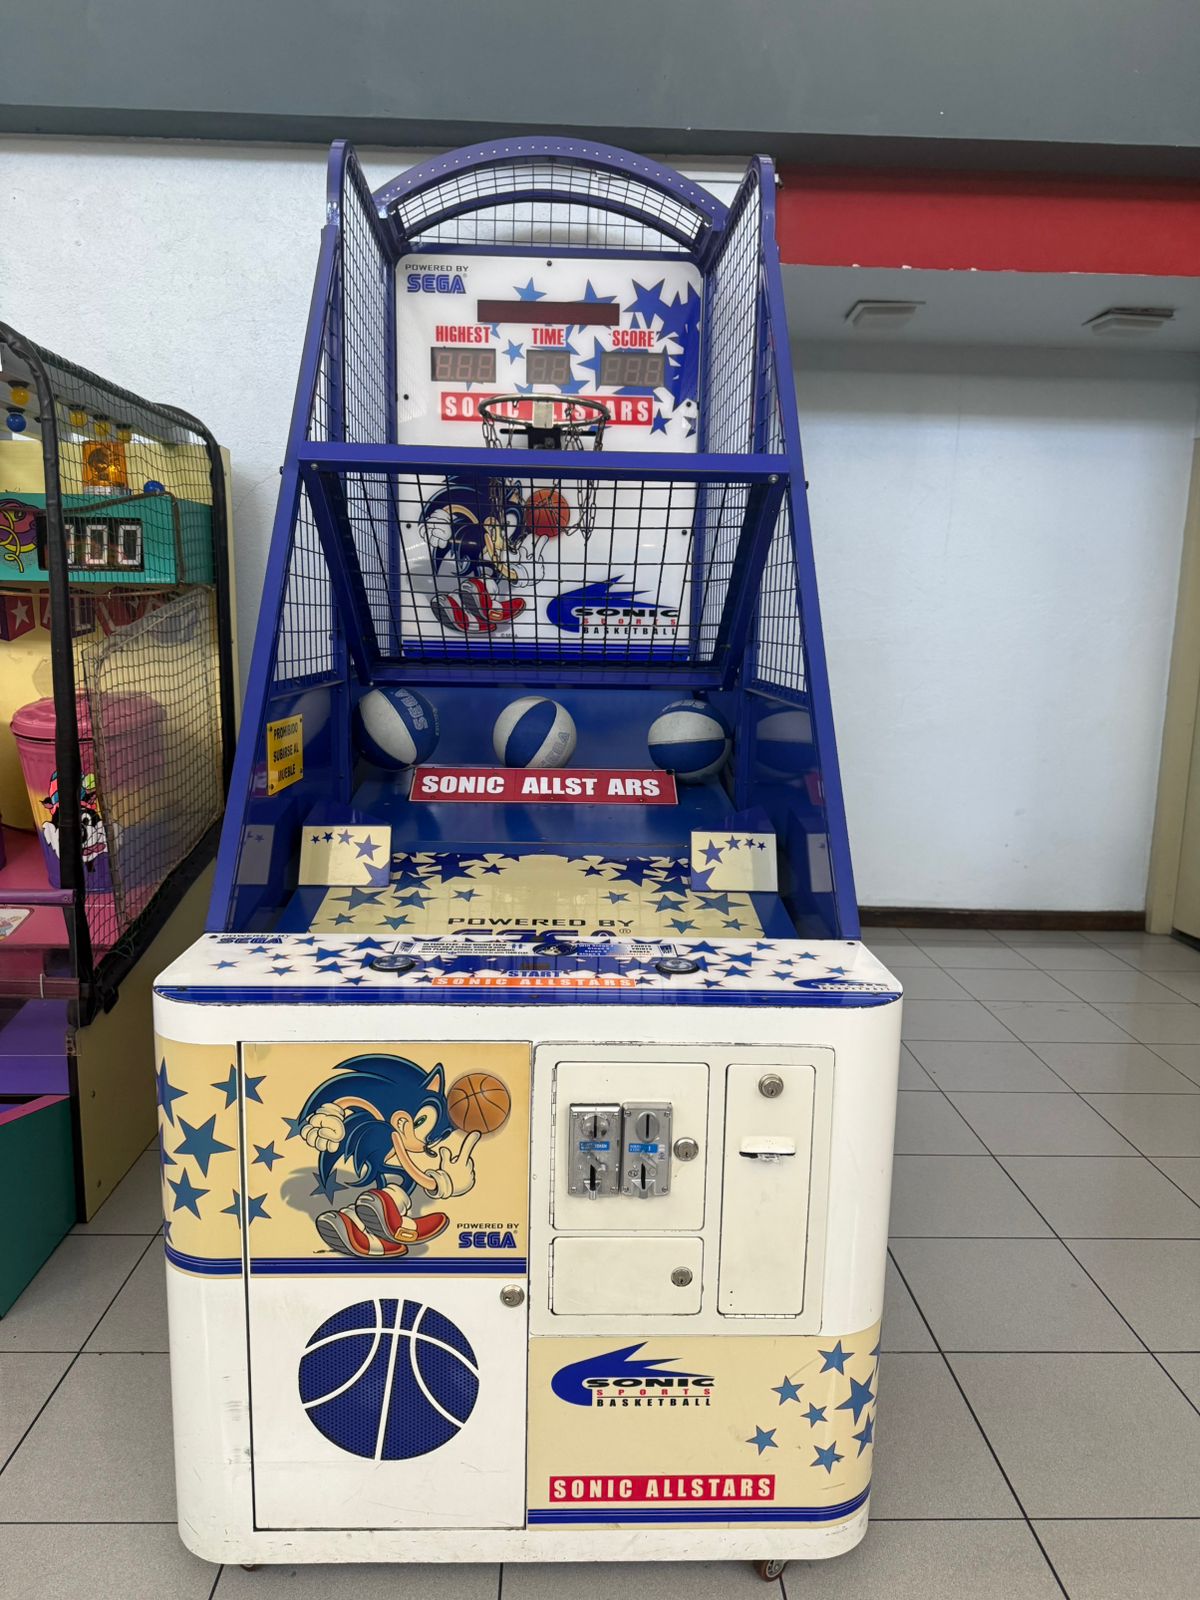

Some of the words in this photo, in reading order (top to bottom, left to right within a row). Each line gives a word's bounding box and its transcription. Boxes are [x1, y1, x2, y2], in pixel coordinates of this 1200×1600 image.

[405, 264, 452, 272] POWERED
[407, 274, 466, 294] SEGA
[435, 325, 491, 344] HIGHEST
[532, 328, 565, 346] TIME
[612, 330, 655, 347] SCORE
[575, 608, 679, 617] SONIC
[582, 626, 677, 636] BASKETBALL
[273, 722, 298, 740] PROHIBIDO
[273, 744, 293, 763] SUBIRSE
[293, 742, 299, 754] AL
[278, 763, 296, 782] MUEBLE
[422, 776, 504, 794] SONIC
[522, 777, 597, 796] ALLST
[608, 779, 660, 797] ARS
[448, 918, 586, 927] POWERED
[598, 919, 634, 927] BY
[519, 978, 632, 986] ALLSTARS
[458, 1231, 517, 1249] SEGA
[586, 1378, 715, 1387] SONIC
[596, 1388, 711, 1396] SPORTS
[596, 1399, 711, 1407] BASKETBALL
[553, 1480, 633, 1498] SONIC
[645, 1478, 771, 1497] ALLSTARS
